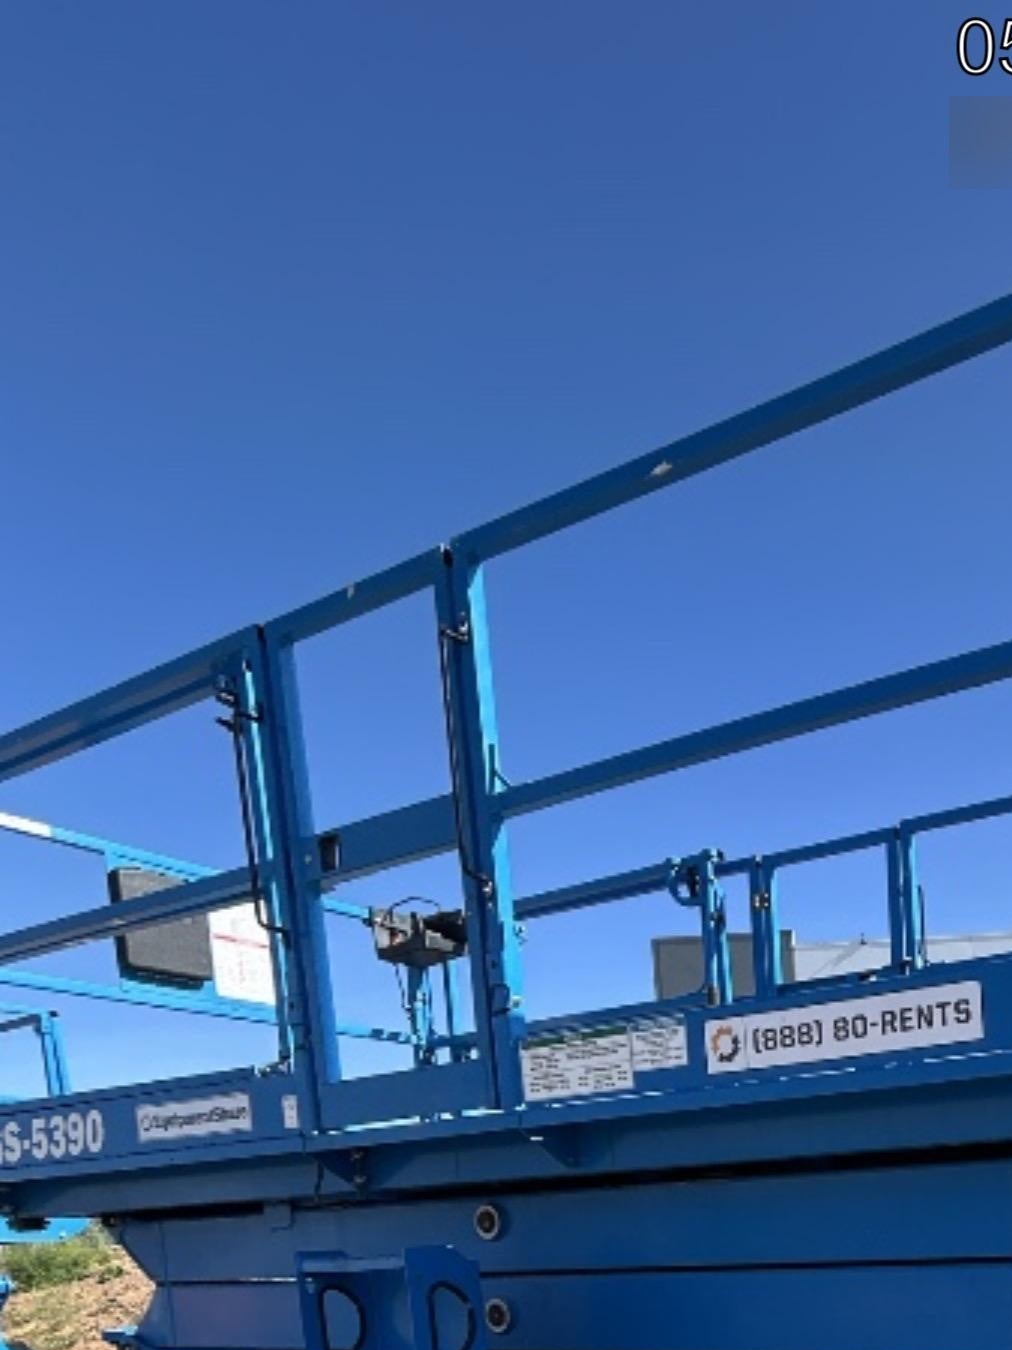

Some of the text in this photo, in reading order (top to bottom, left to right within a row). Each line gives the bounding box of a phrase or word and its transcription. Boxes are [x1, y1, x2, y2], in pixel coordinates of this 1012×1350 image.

[752, 998, 973, 1053] (888) 80-RENTS
[0, 1108, 104, 1165] S-5390
